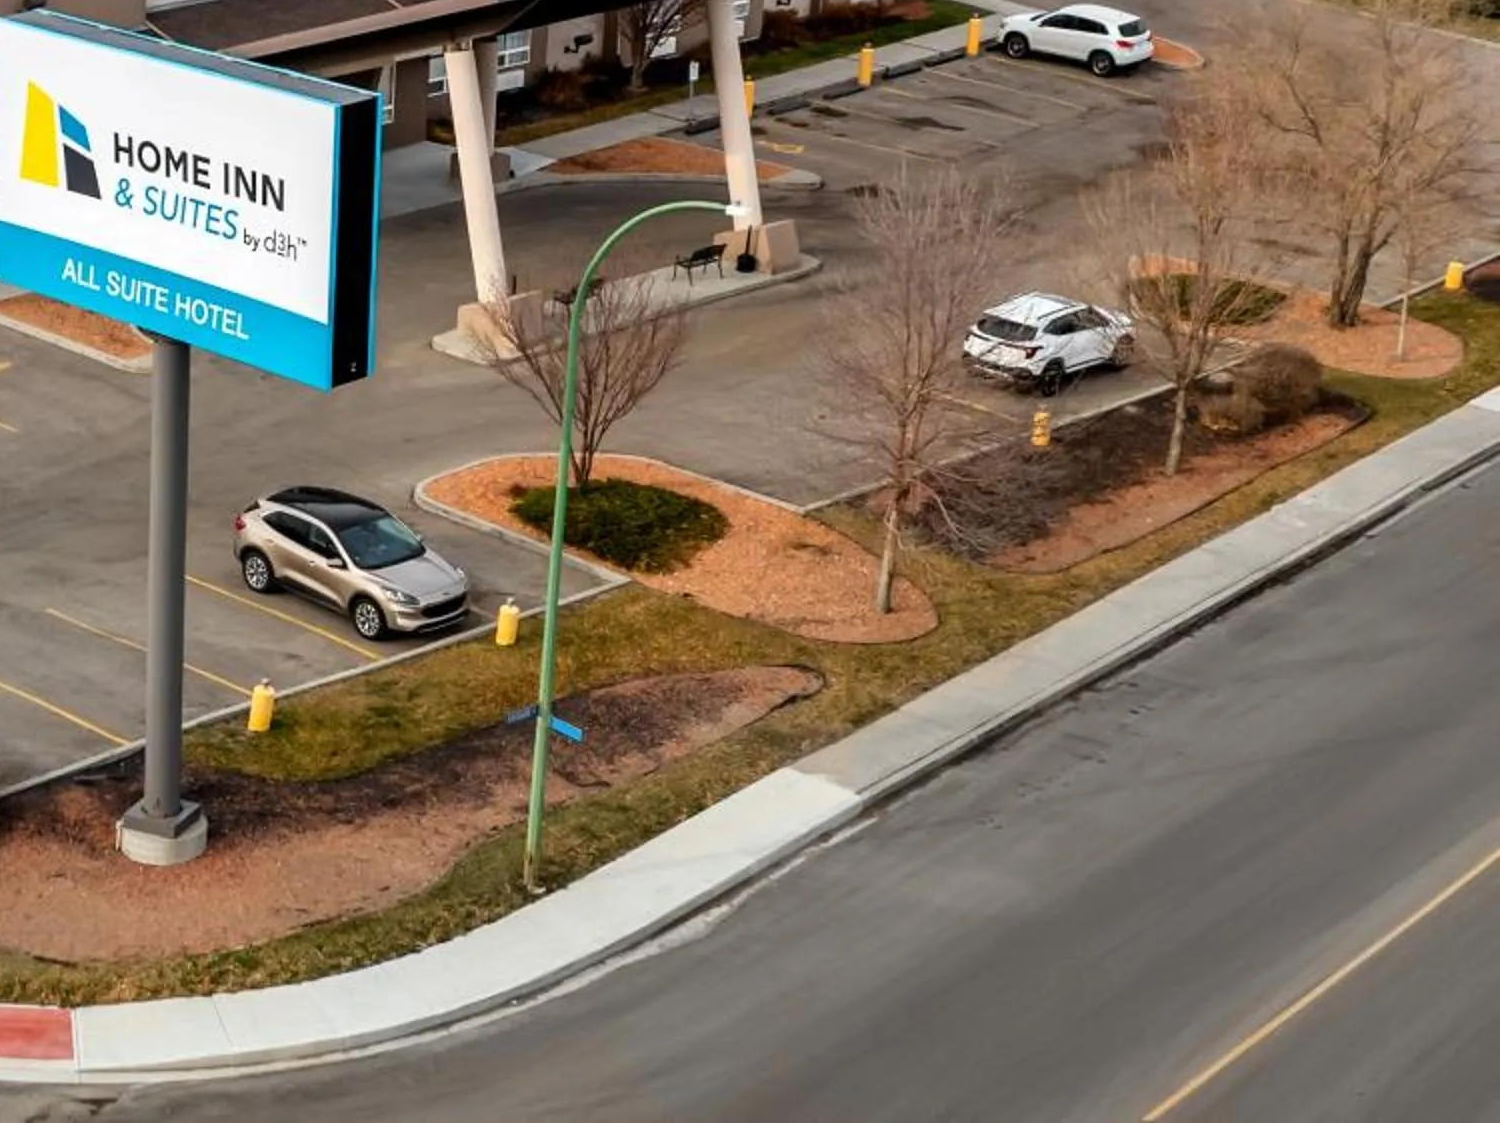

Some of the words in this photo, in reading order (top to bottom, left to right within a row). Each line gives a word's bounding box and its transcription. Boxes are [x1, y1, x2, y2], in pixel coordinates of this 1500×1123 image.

[113, 132, 211, 190] HOME
[223, 162, 285, 212] INN
[114, 178, 134, 209] &
[142, 185, 239, 240] SUITES
[243, 227, 261, 252] by
[61, 258, 100, 291] ALL
[106, 271, 169, 313] SUITE
[175, 293, 250, 340] HOTEL
